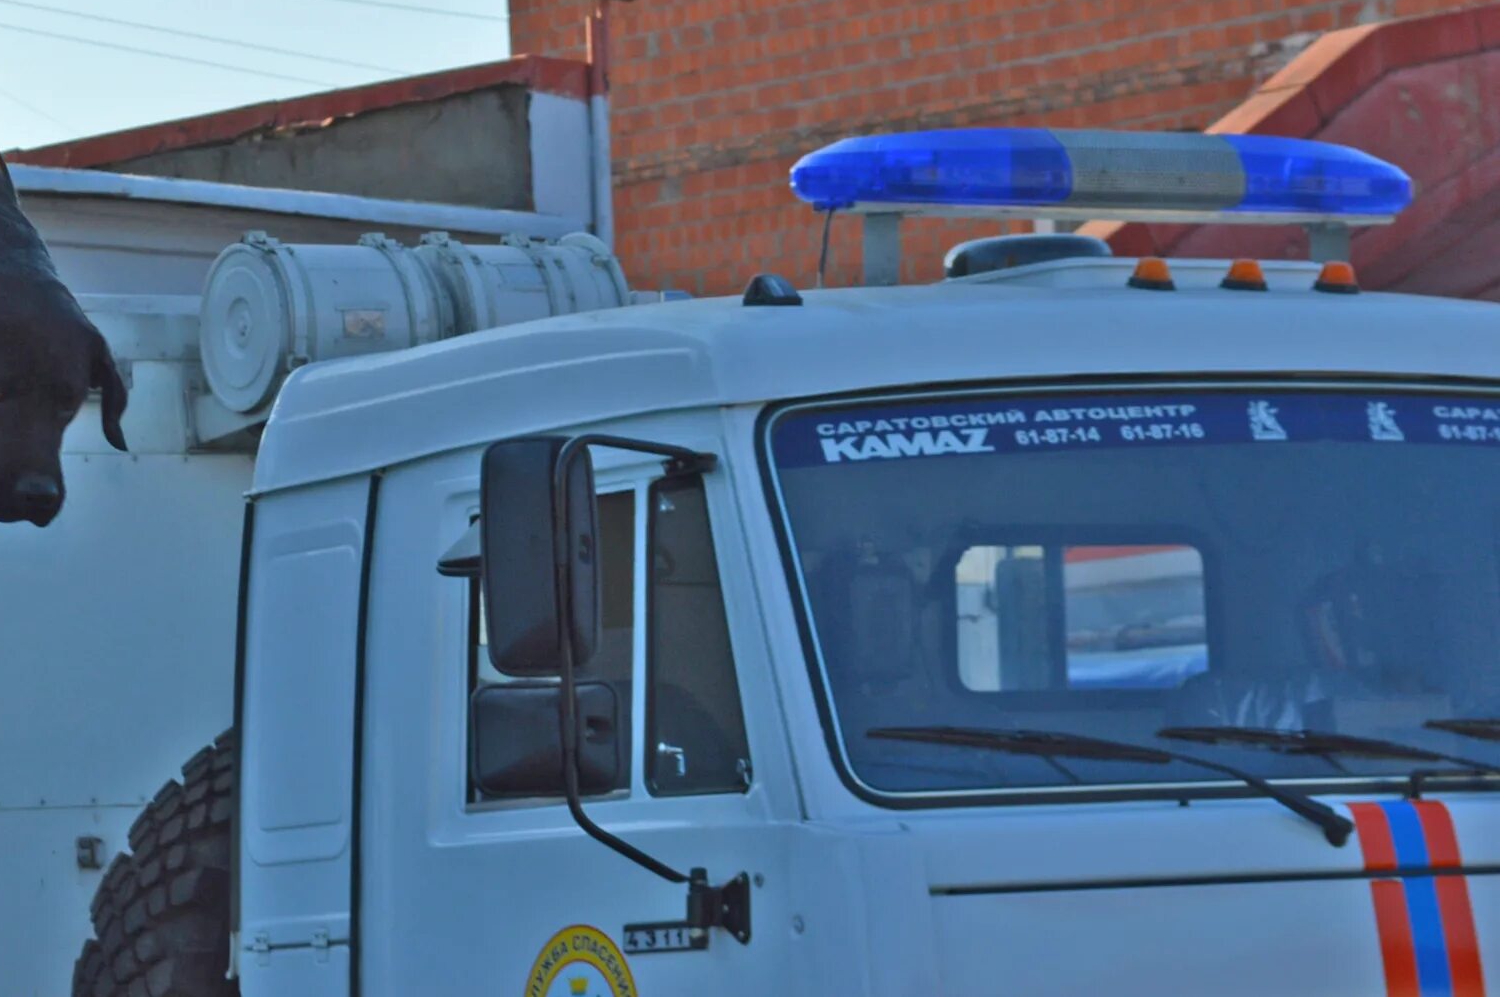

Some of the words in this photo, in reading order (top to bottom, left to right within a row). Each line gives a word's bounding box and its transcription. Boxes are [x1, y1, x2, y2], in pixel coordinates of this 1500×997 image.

[816, 409, 1026, 435] САРАТОВСКИЙ
[1034, 404, 1197, 422] АВТОЦЕНТР
[1432, 406, 1500, 421] САРА
[820, 428, 995, 462] KAMAZ
[1015, 426, 1101, 445] 61-87-14
[1120, 423, 1204, 441] 61-87-16
[572, 934, 631, 997] СПАСЕНИ
